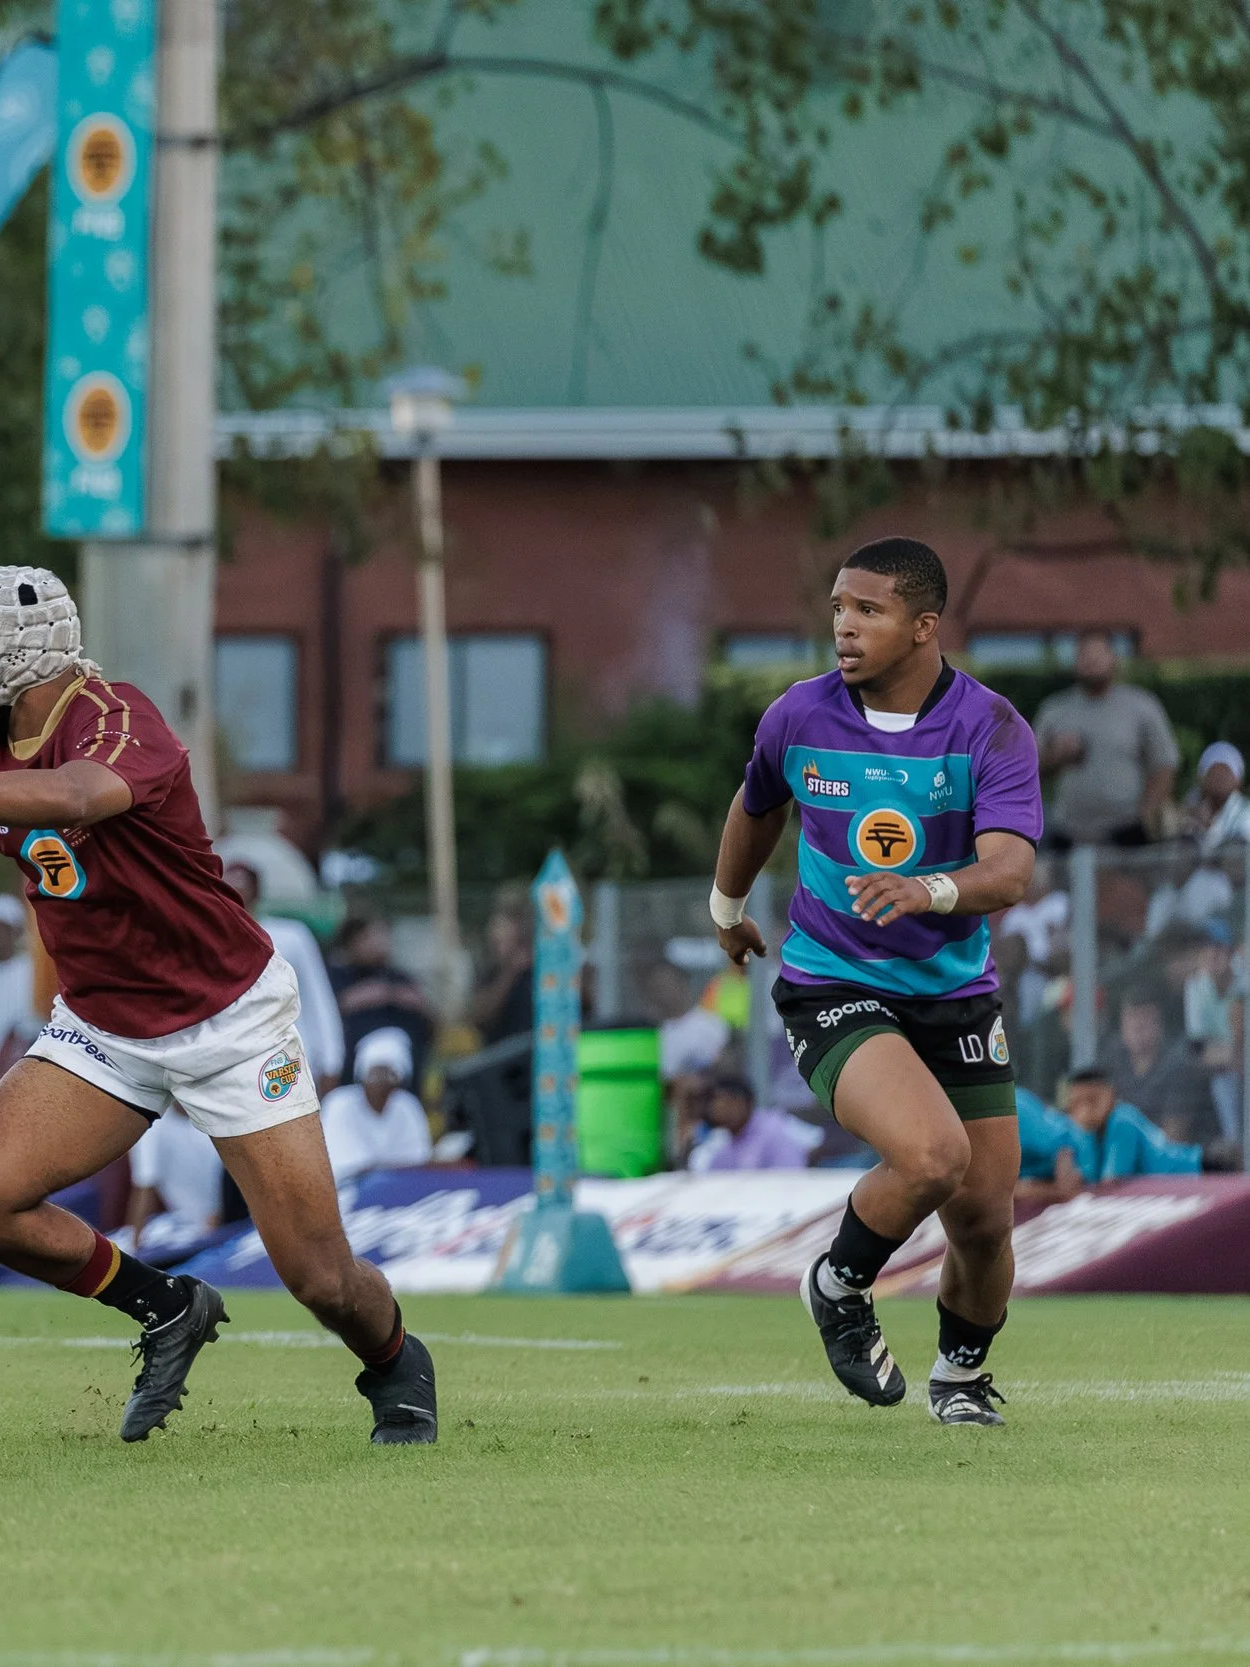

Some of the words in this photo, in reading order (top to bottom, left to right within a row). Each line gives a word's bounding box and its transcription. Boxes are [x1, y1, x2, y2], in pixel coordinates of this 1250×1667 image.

[865, 768, 887, 776] NWU
[807, 777, 849, 797] STEERS
[929, 786, 953, 801] NWU
[958, 1034, 984, 1063] LD
[265, 1061, 300, 1080] VARSITY
[280, 1072, 296, 1085] CUP
